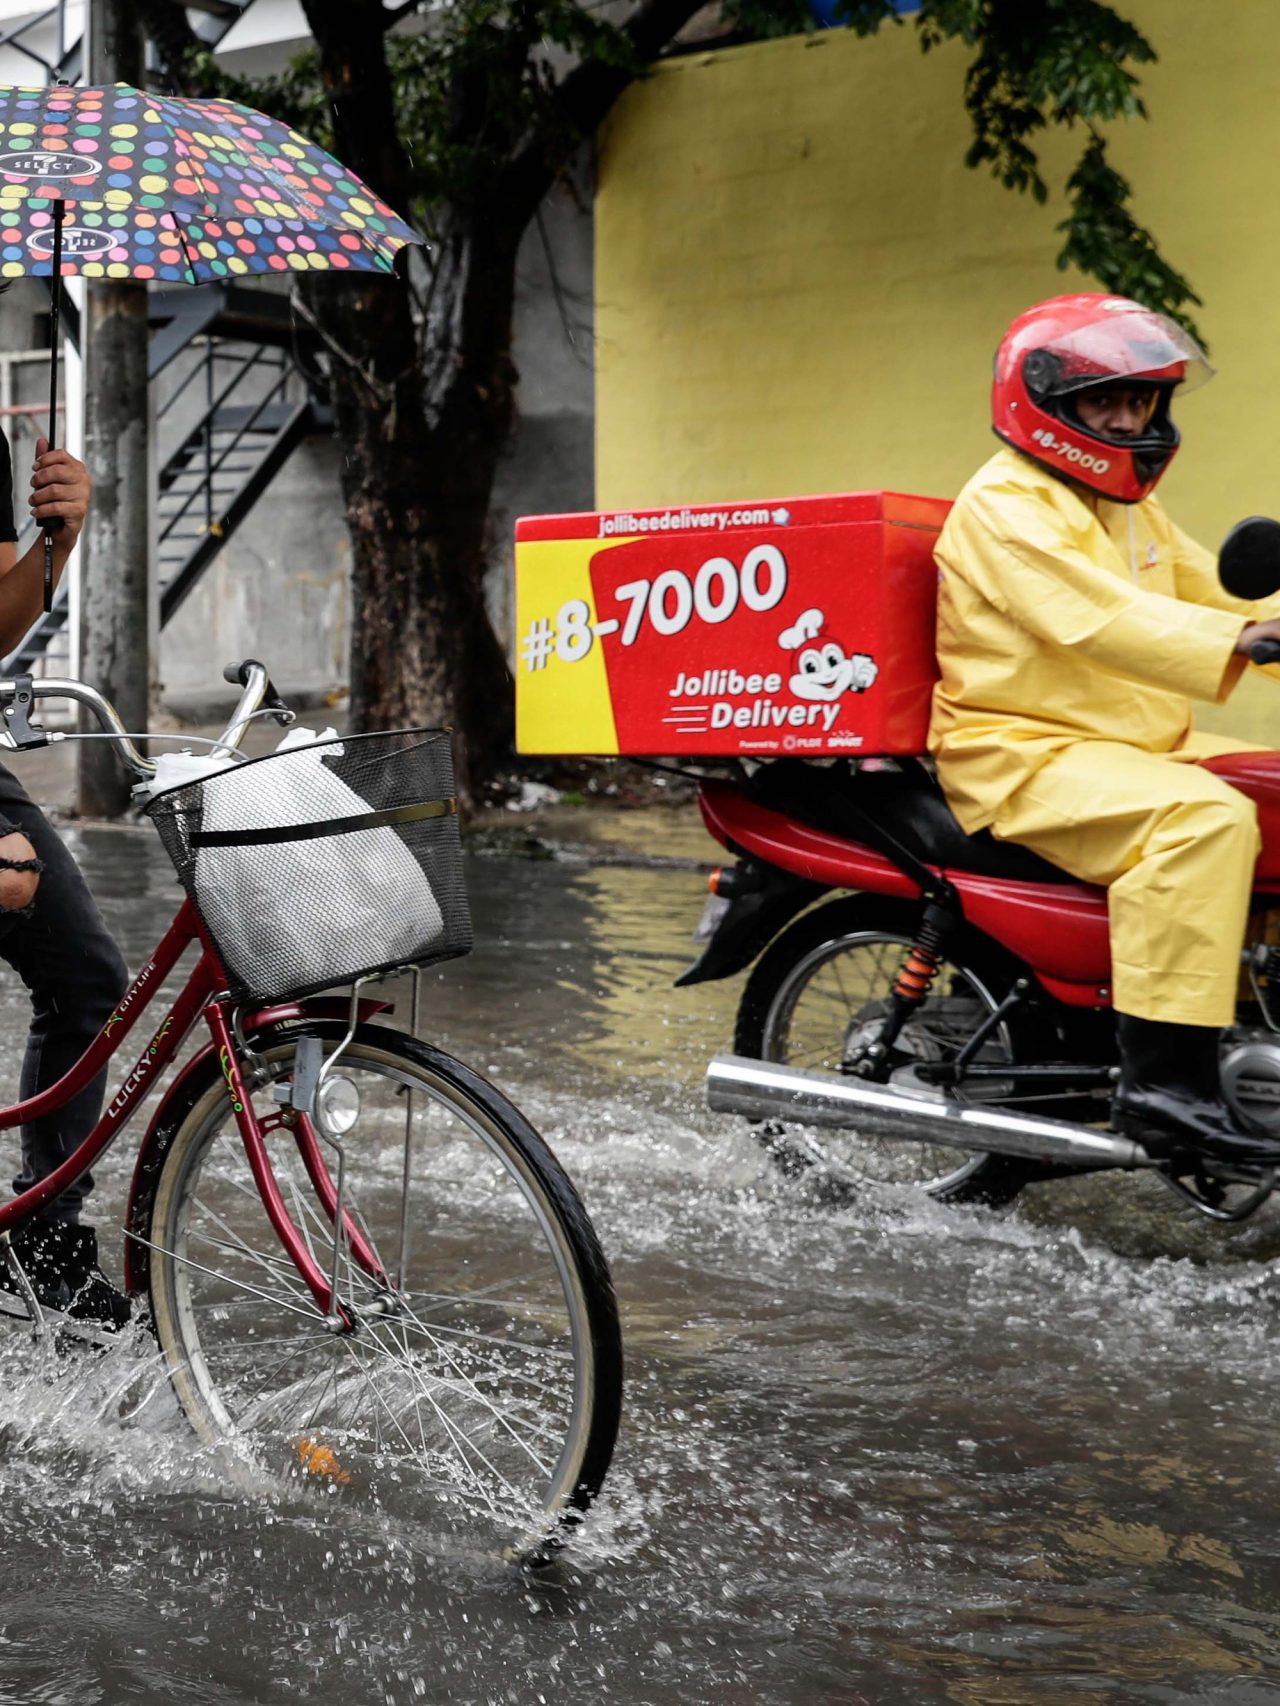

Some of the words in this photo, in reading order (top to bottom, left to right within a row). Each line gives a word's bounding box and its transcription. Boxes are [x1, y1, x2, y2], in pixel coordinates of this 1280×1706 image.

[14, 161, 72, 170] SELECT
[598, 509, 770, 538] jollibeedelivery.com
[521, 544, 787, 671] #8-7000
[669, 669, 781, 698] Jollibee
[710, 701, 841, 732] Delivery
[120, 985, 138, 1013] CITY
[137, 961, 157, 987] LIFE
[108, 1051, 152, 1119] LUCKY
